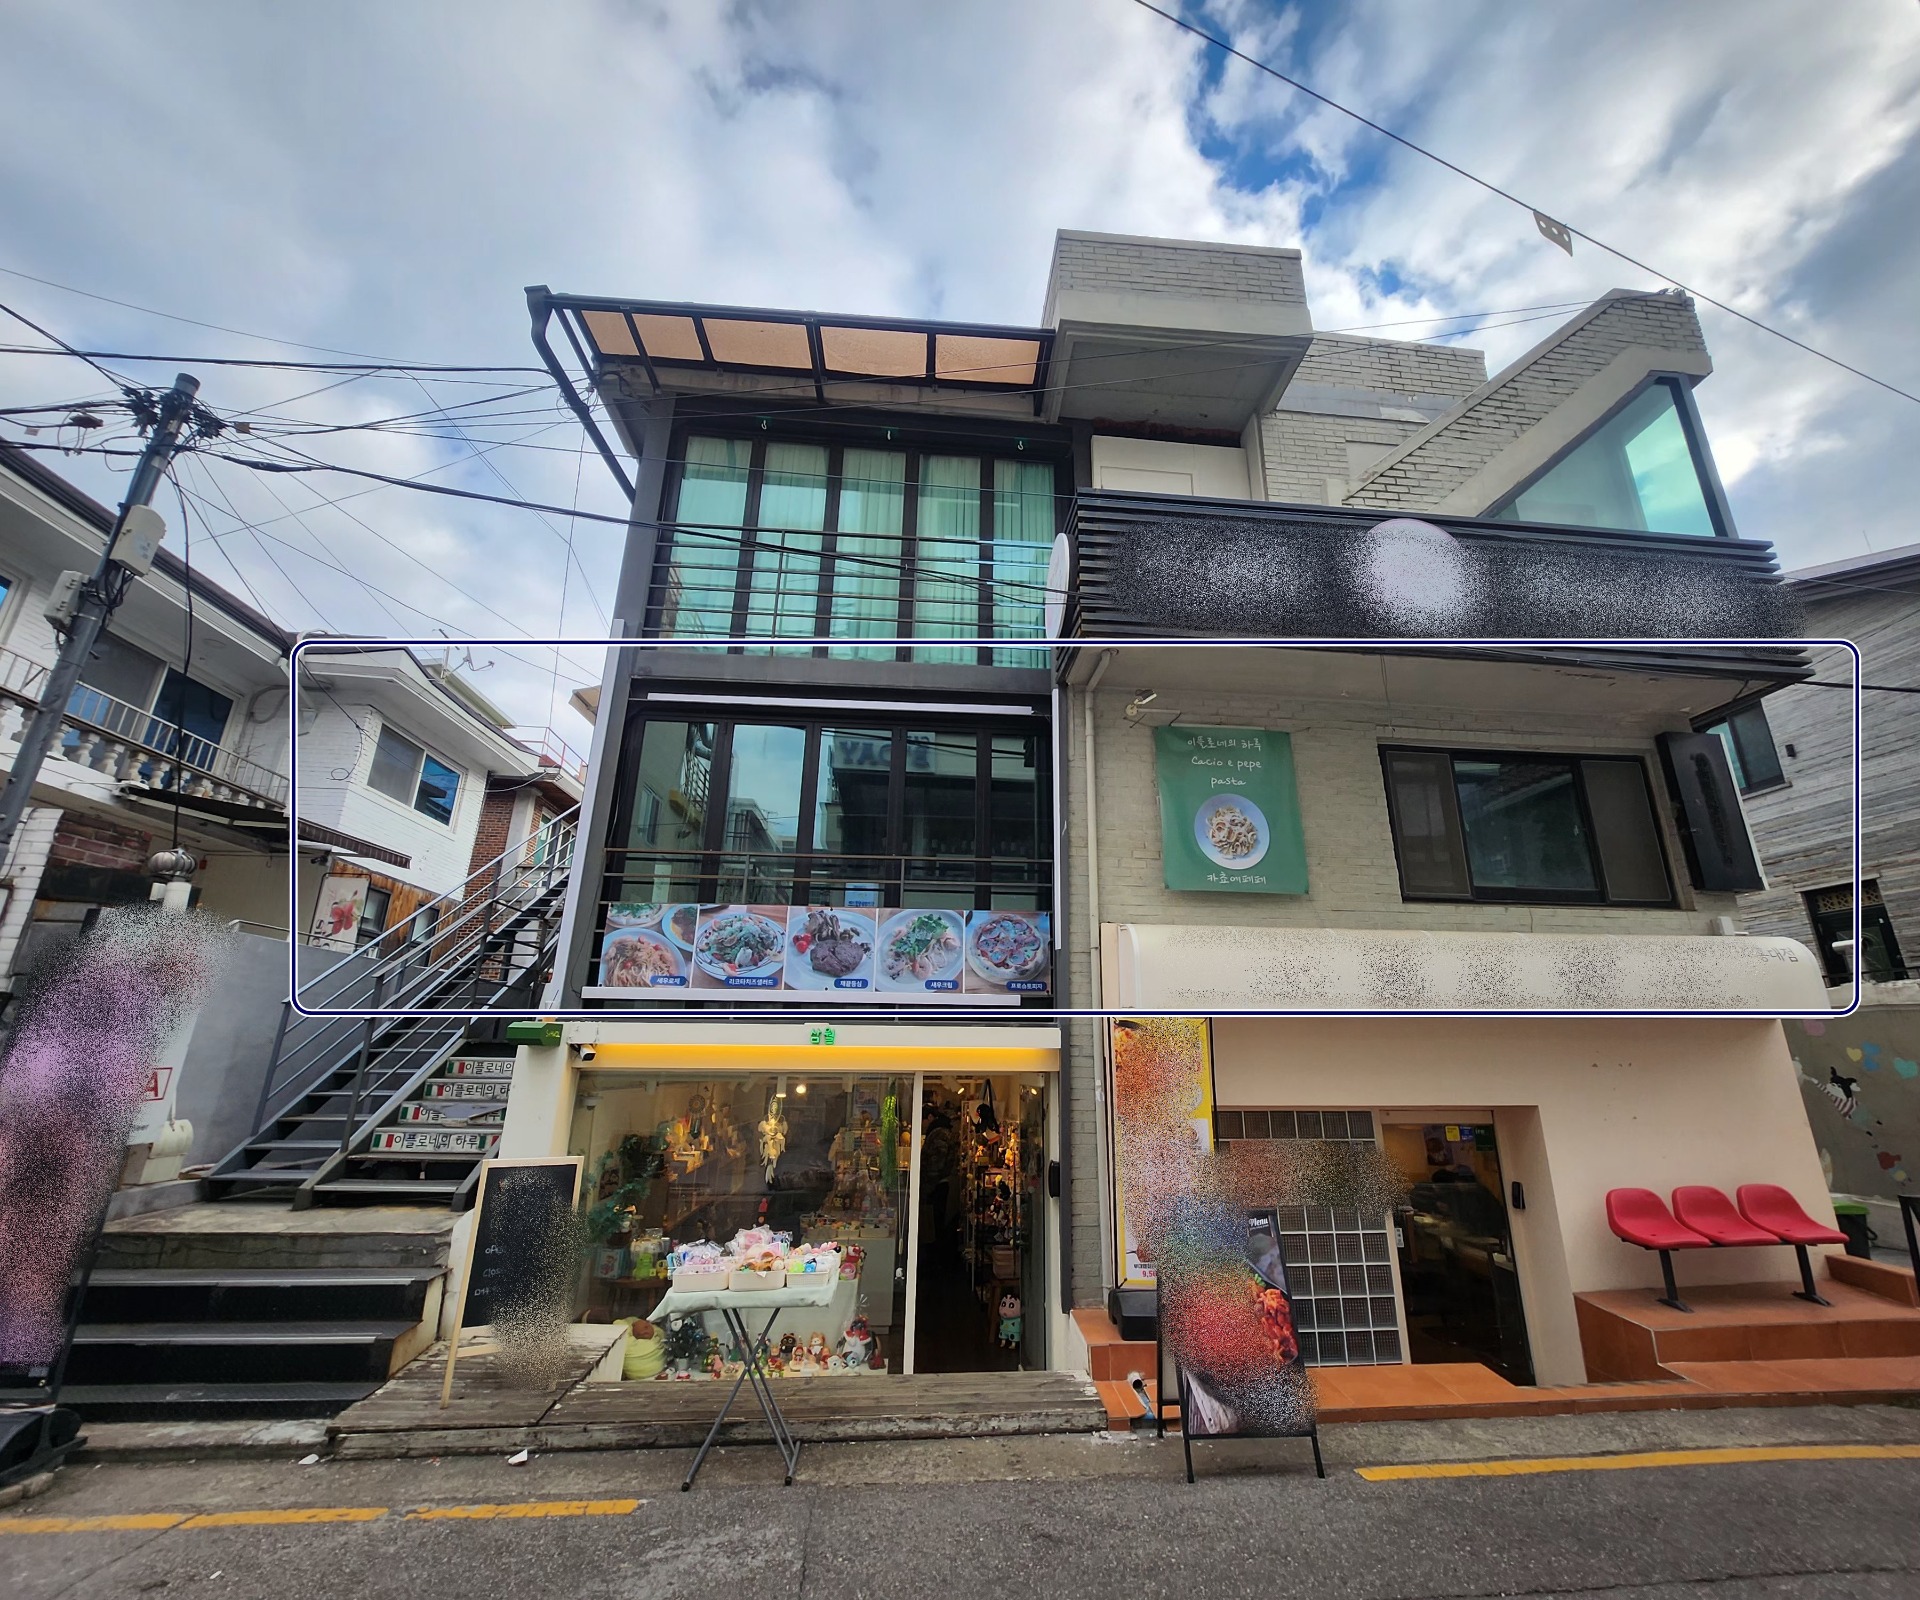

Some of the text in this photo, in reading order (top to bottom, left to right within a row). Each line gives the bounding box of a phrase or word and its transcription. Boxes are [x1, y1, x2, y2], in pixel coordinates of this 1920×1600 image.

[1241, 737, 1261, 751] 하루
[1191, 756, 1223, 766] Cacio
[1237, 760, 1262, 772] pepe
[1211, 777, 1246, 788] pasta
[811, 1027, 835, 1045] 삼월
[465, 1060, 513, 1075] 이플로네의
[444, 1083, 510, 1097] 이플로네의 하
[394, 1133, 479, 1149] 이플로네의 하루
